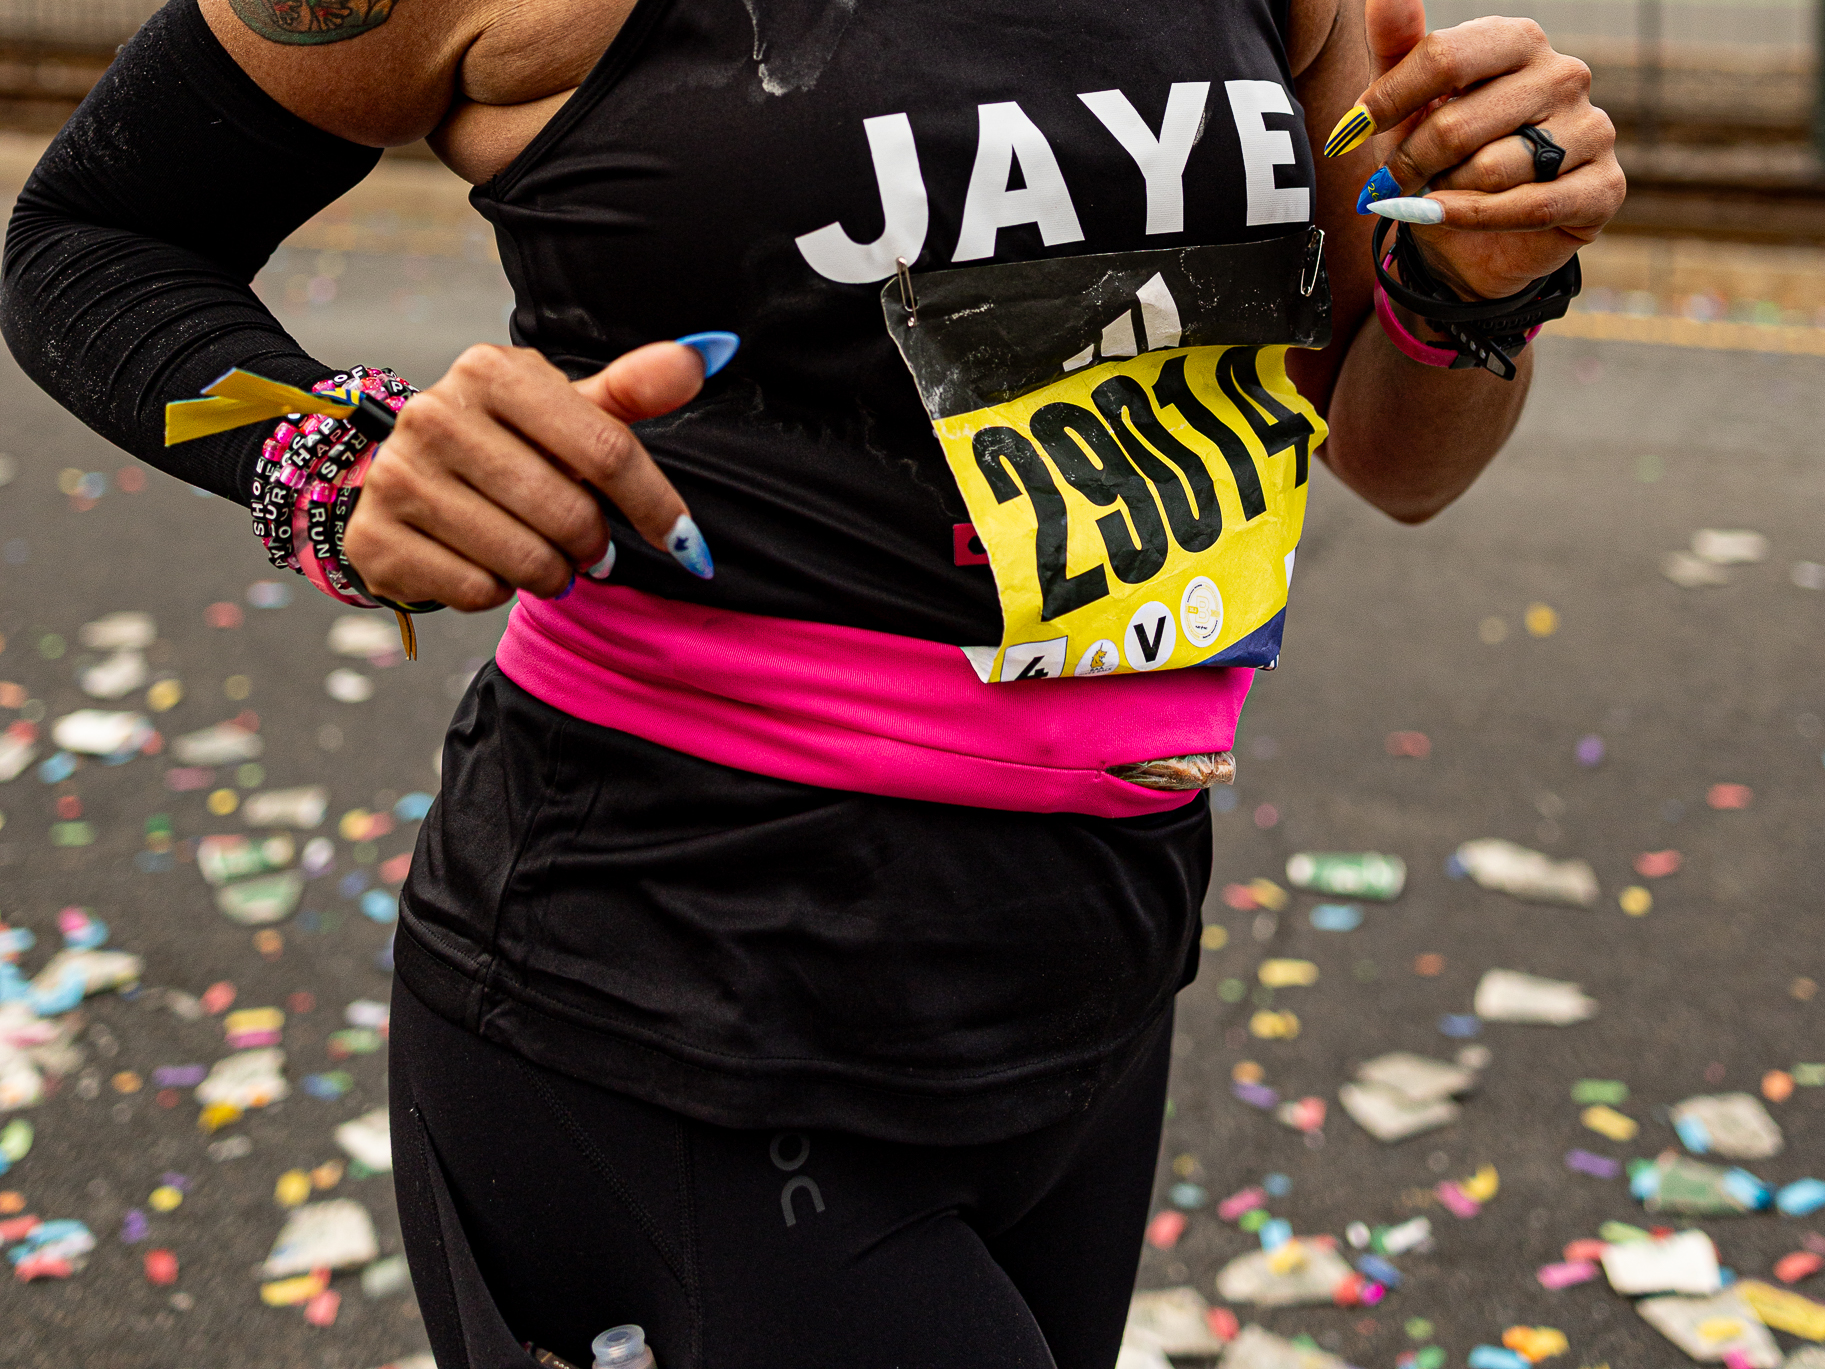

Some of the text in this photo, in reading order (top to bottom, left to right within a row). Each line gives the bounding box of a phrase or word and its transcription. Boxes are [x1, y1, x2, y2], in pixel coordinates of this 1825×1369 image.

[795, 80, 1311, 284] JAYE
[972, 345, 1315, 622] 29014
[311, 507, 330, 558] RUN
[1134, 615, 1167, 663] V
[1014, 655, 1049, 680] 4
